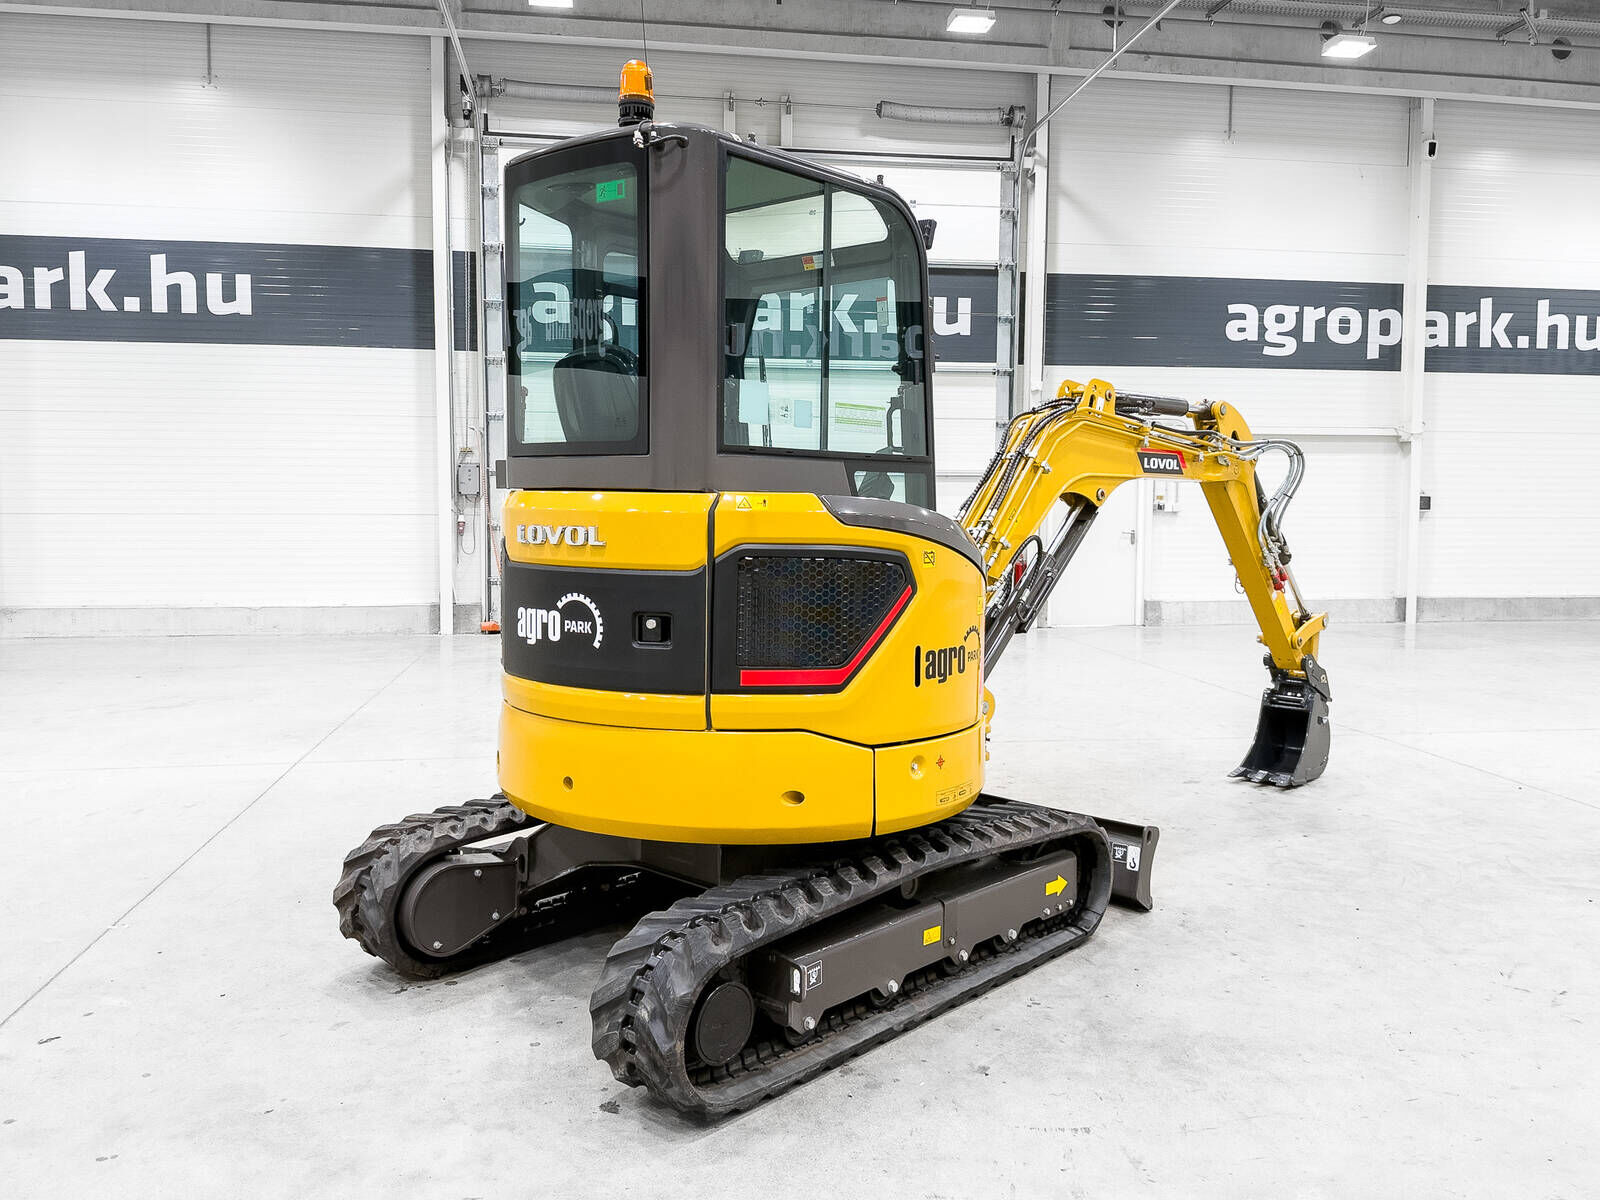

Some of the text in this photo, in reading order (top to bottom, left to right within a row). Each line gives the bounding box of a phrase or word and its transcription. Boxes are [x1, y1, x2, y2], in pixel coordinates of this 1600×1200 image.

[1143, 457, 1180, 470] LOVOL
[516, 524, 606, 546] LOVOL
[517, 606, 592, 645] agro PARK
[925, 645, 966, 684] agro
